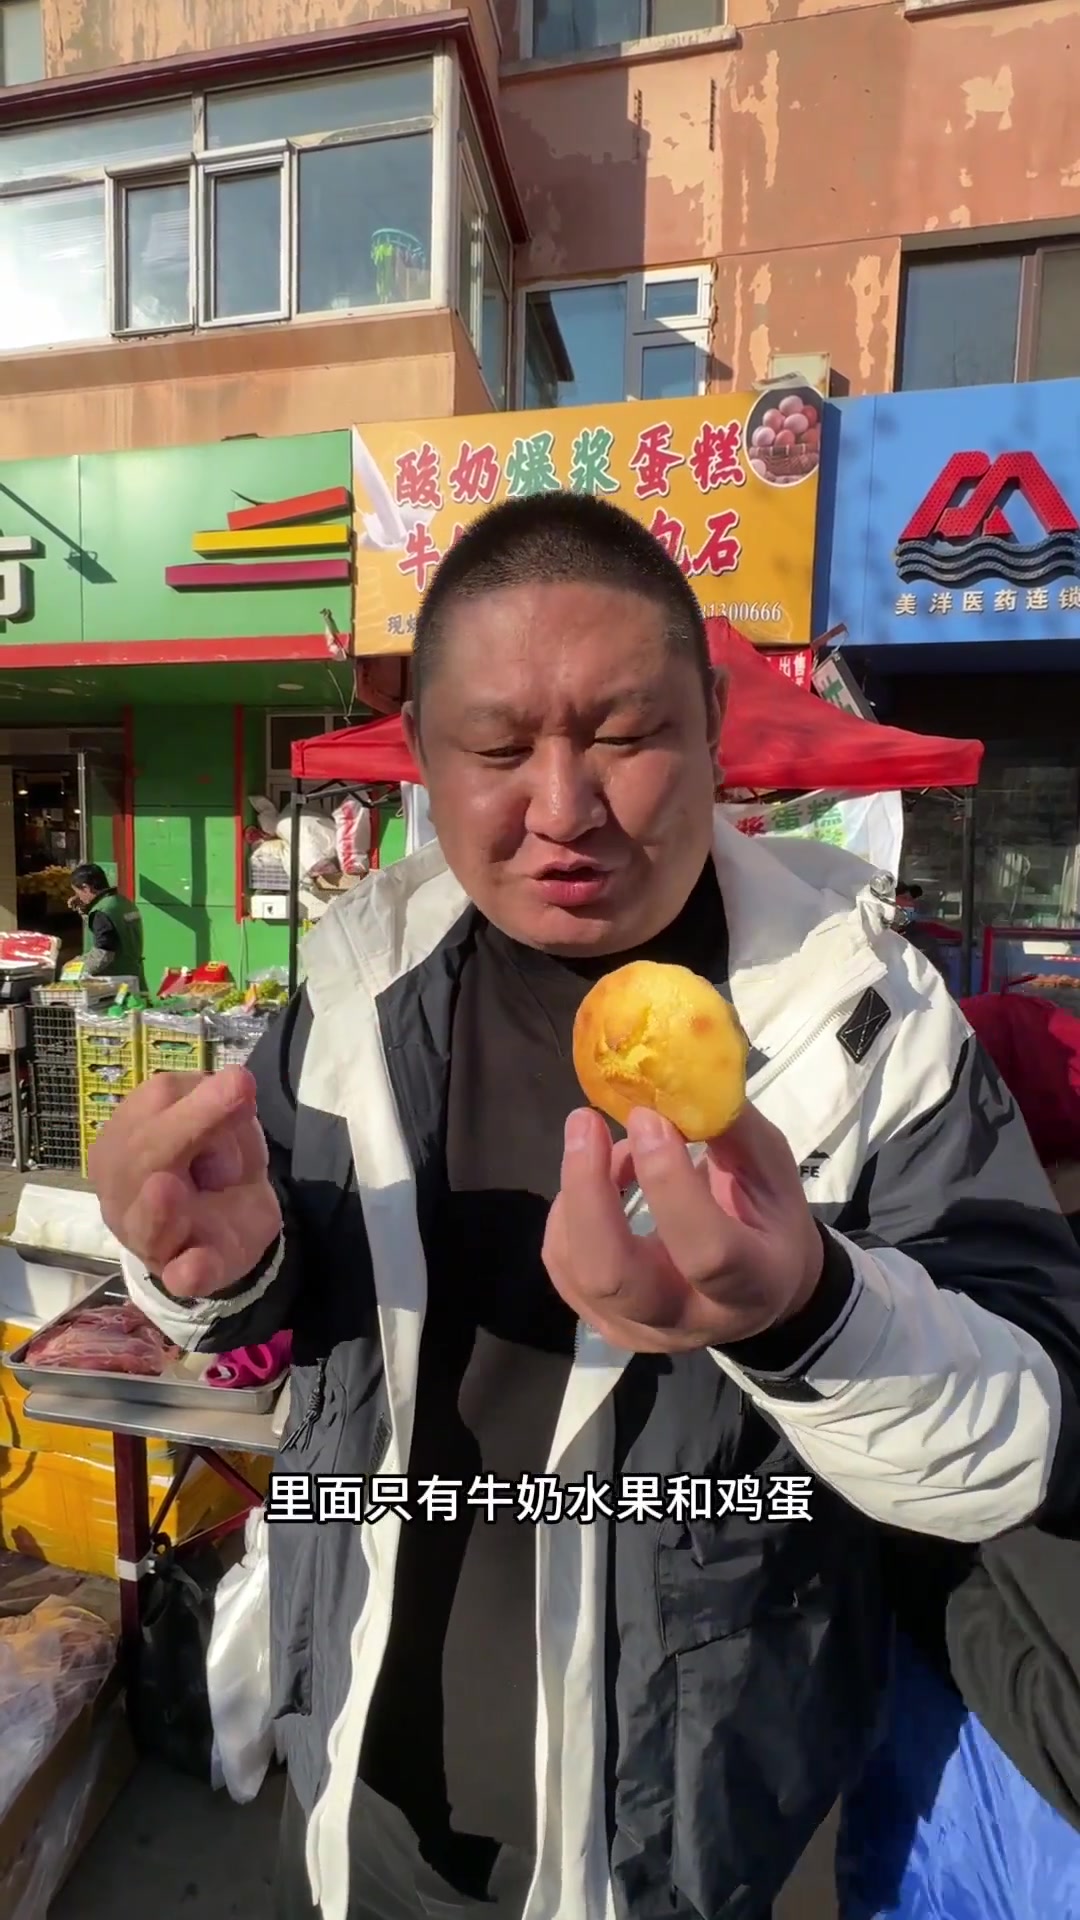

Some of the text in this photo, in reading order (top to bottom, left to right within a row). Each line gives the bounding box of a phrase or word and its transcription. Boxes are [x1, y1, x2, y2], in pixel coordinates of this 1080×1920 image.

[394, 420, 747, 509] 酸奶爆浆蛋糕
[702, 601, 781, 622] 1300666
[895, 586, 1080, 616] 美洋医药连锁
